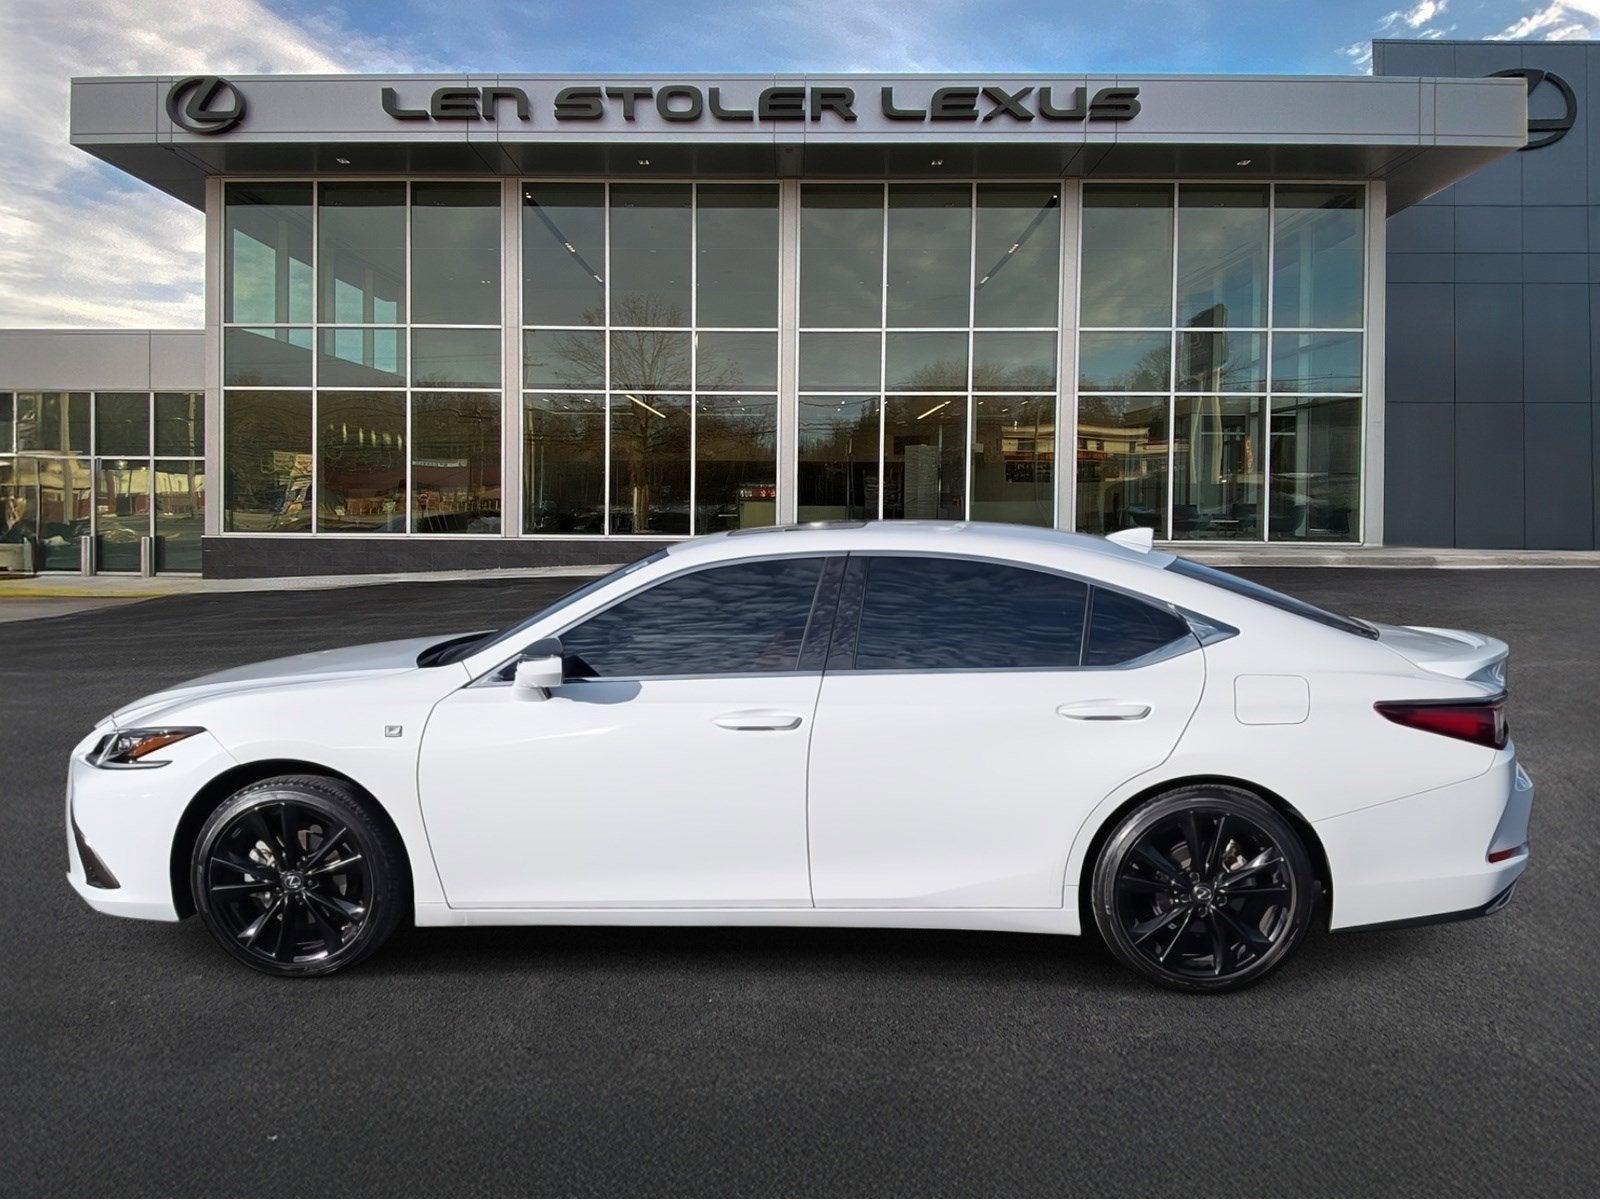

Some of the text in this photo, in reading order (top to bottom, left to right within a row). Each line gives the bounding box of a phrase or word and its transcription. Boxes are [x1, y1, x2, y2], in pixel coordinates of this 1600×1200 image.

[381, 85, 1142, 122] LEN STOLER LEXUS
